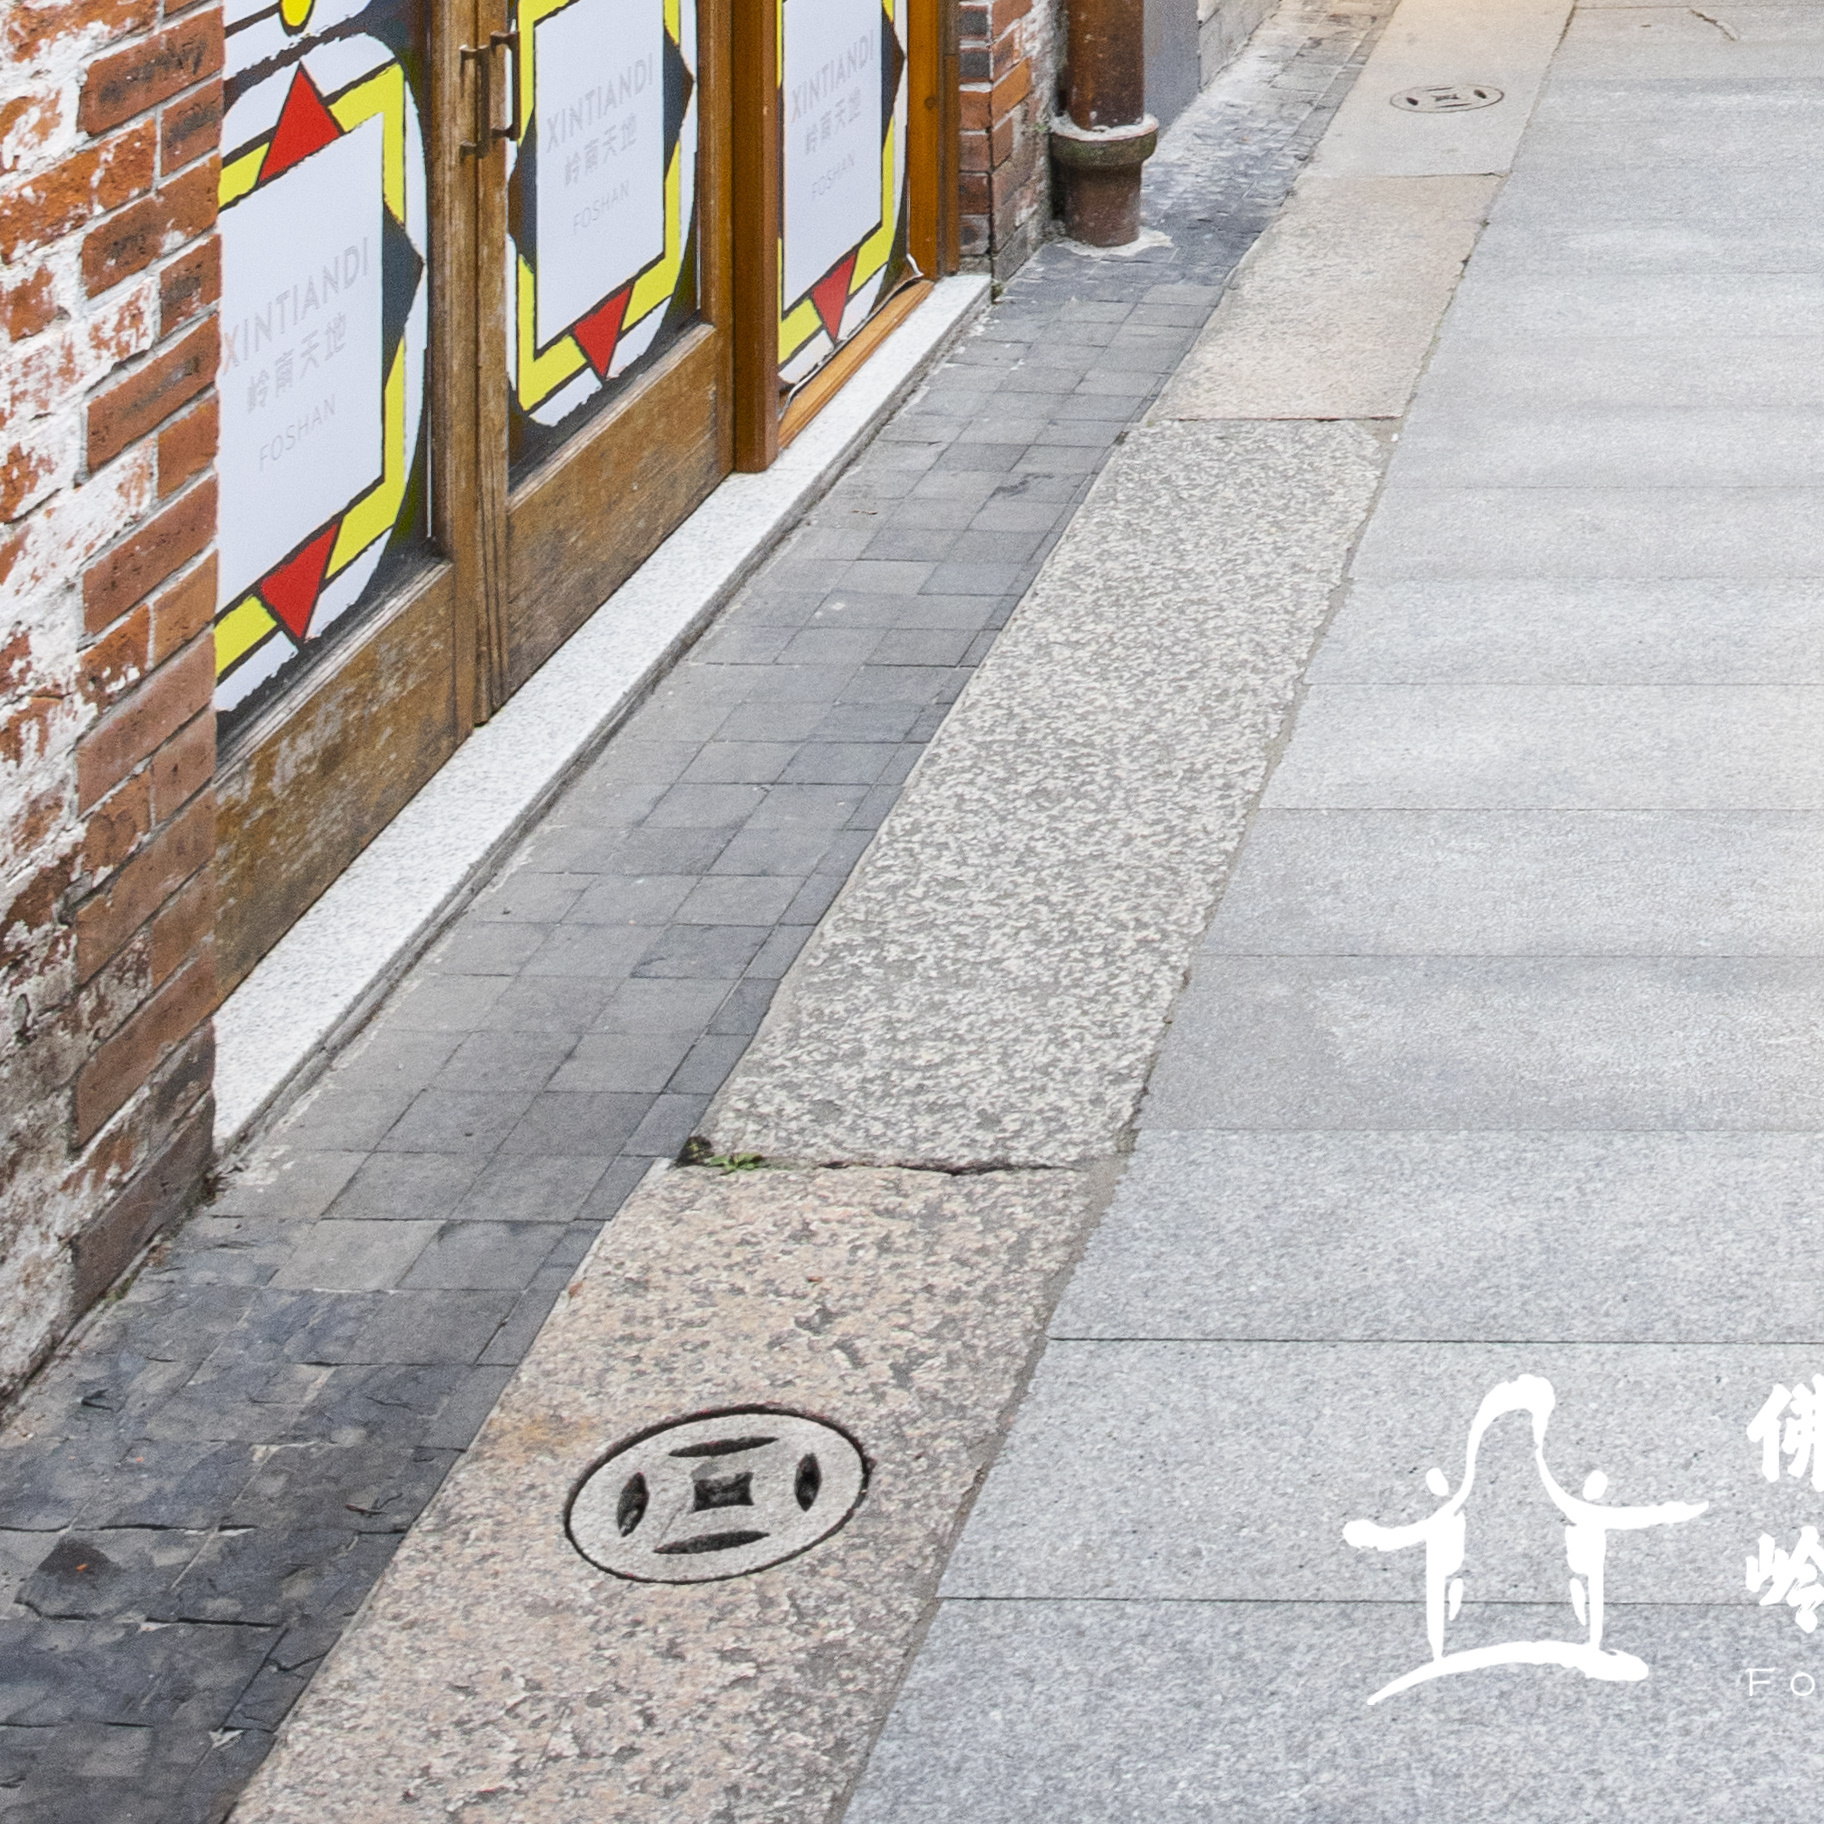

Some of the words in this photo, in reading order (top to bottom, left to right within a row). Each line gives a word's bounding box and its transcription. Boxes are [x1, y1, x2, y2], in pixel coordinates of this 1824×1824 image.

[545, 56, 653, 153] XINTIANDI
[563, 112, 638, 186] 岭南天地
[573, 180, 630, 234] FOSHAN
[246, 312, 347, 414] 岭南天地
[259, 394, 336, 471] FOSHAN
